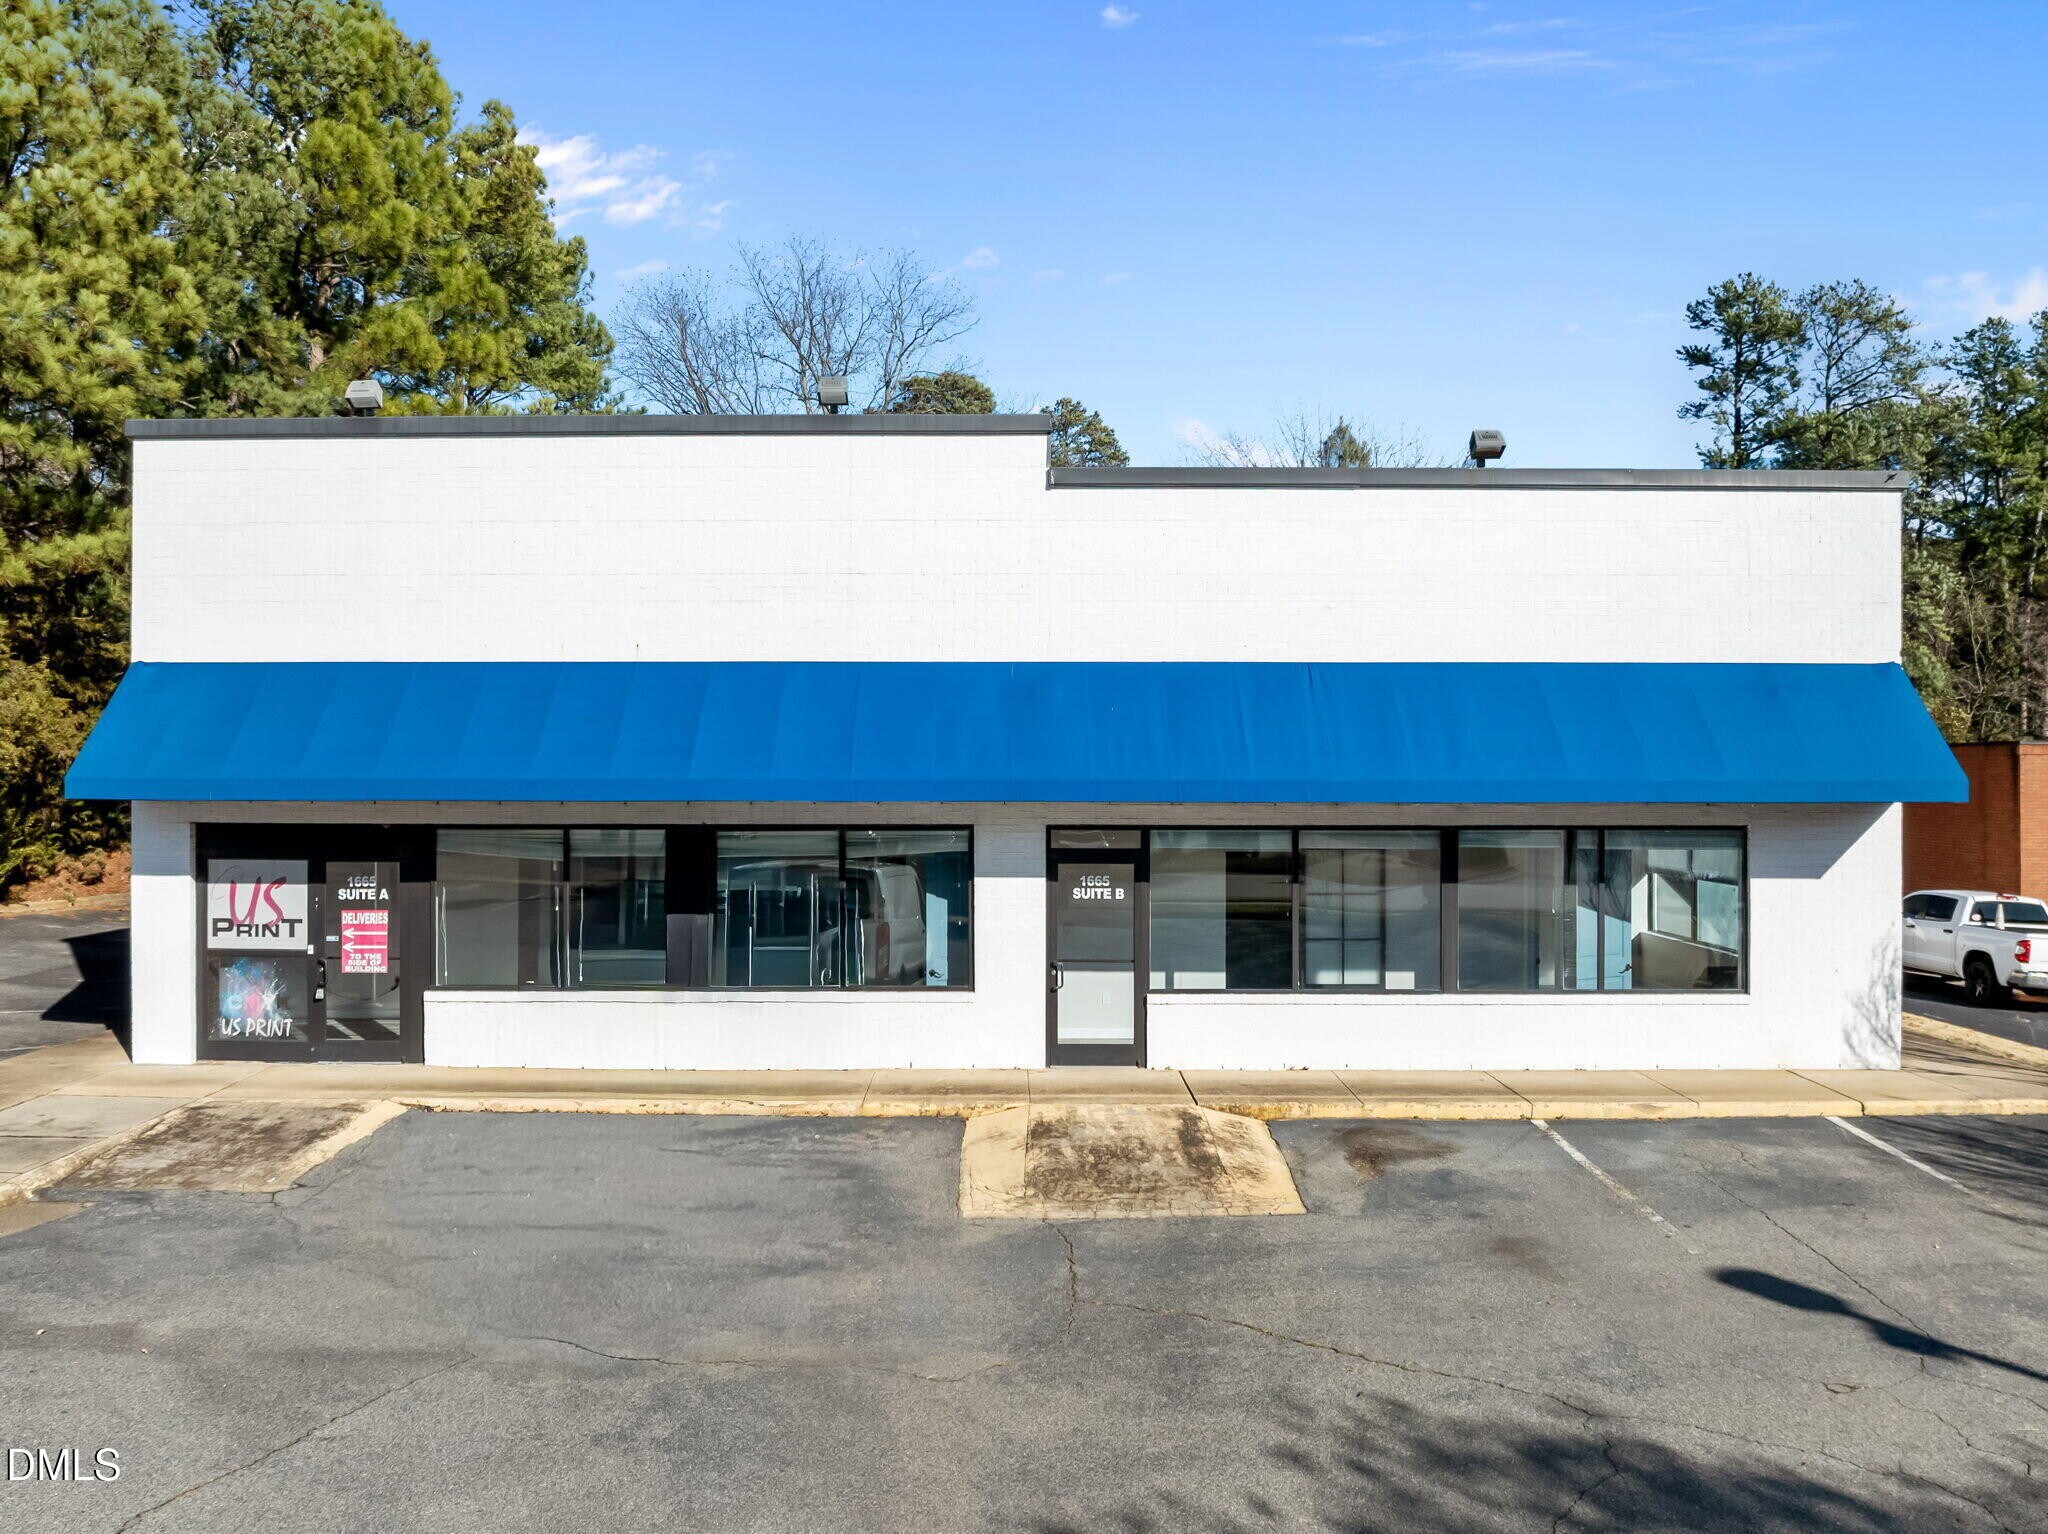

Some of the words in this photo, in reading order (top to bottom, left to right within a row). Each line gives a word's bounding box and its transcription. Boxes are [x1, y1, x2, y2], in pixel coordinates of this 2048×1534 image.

[347, 876, 376, 887] 1665
[1080, 875, 1110, 886] 1665
[338, 888, 376, 900] SUITE
[379, 889, 389, 900] A
[1072, 888, 1112, 900] SUITE
[1116, 888, 1125, 900] B
[229, 876, 287, 927] US
[342, 912, 388, 924] DELIVERIES
[212, 918, 303, 938] PRINT
[344, 965, 387, 973] BUILDING
[221, 1018, 241, 1036] US
[245, 1018, 293, 1037] PRINT
